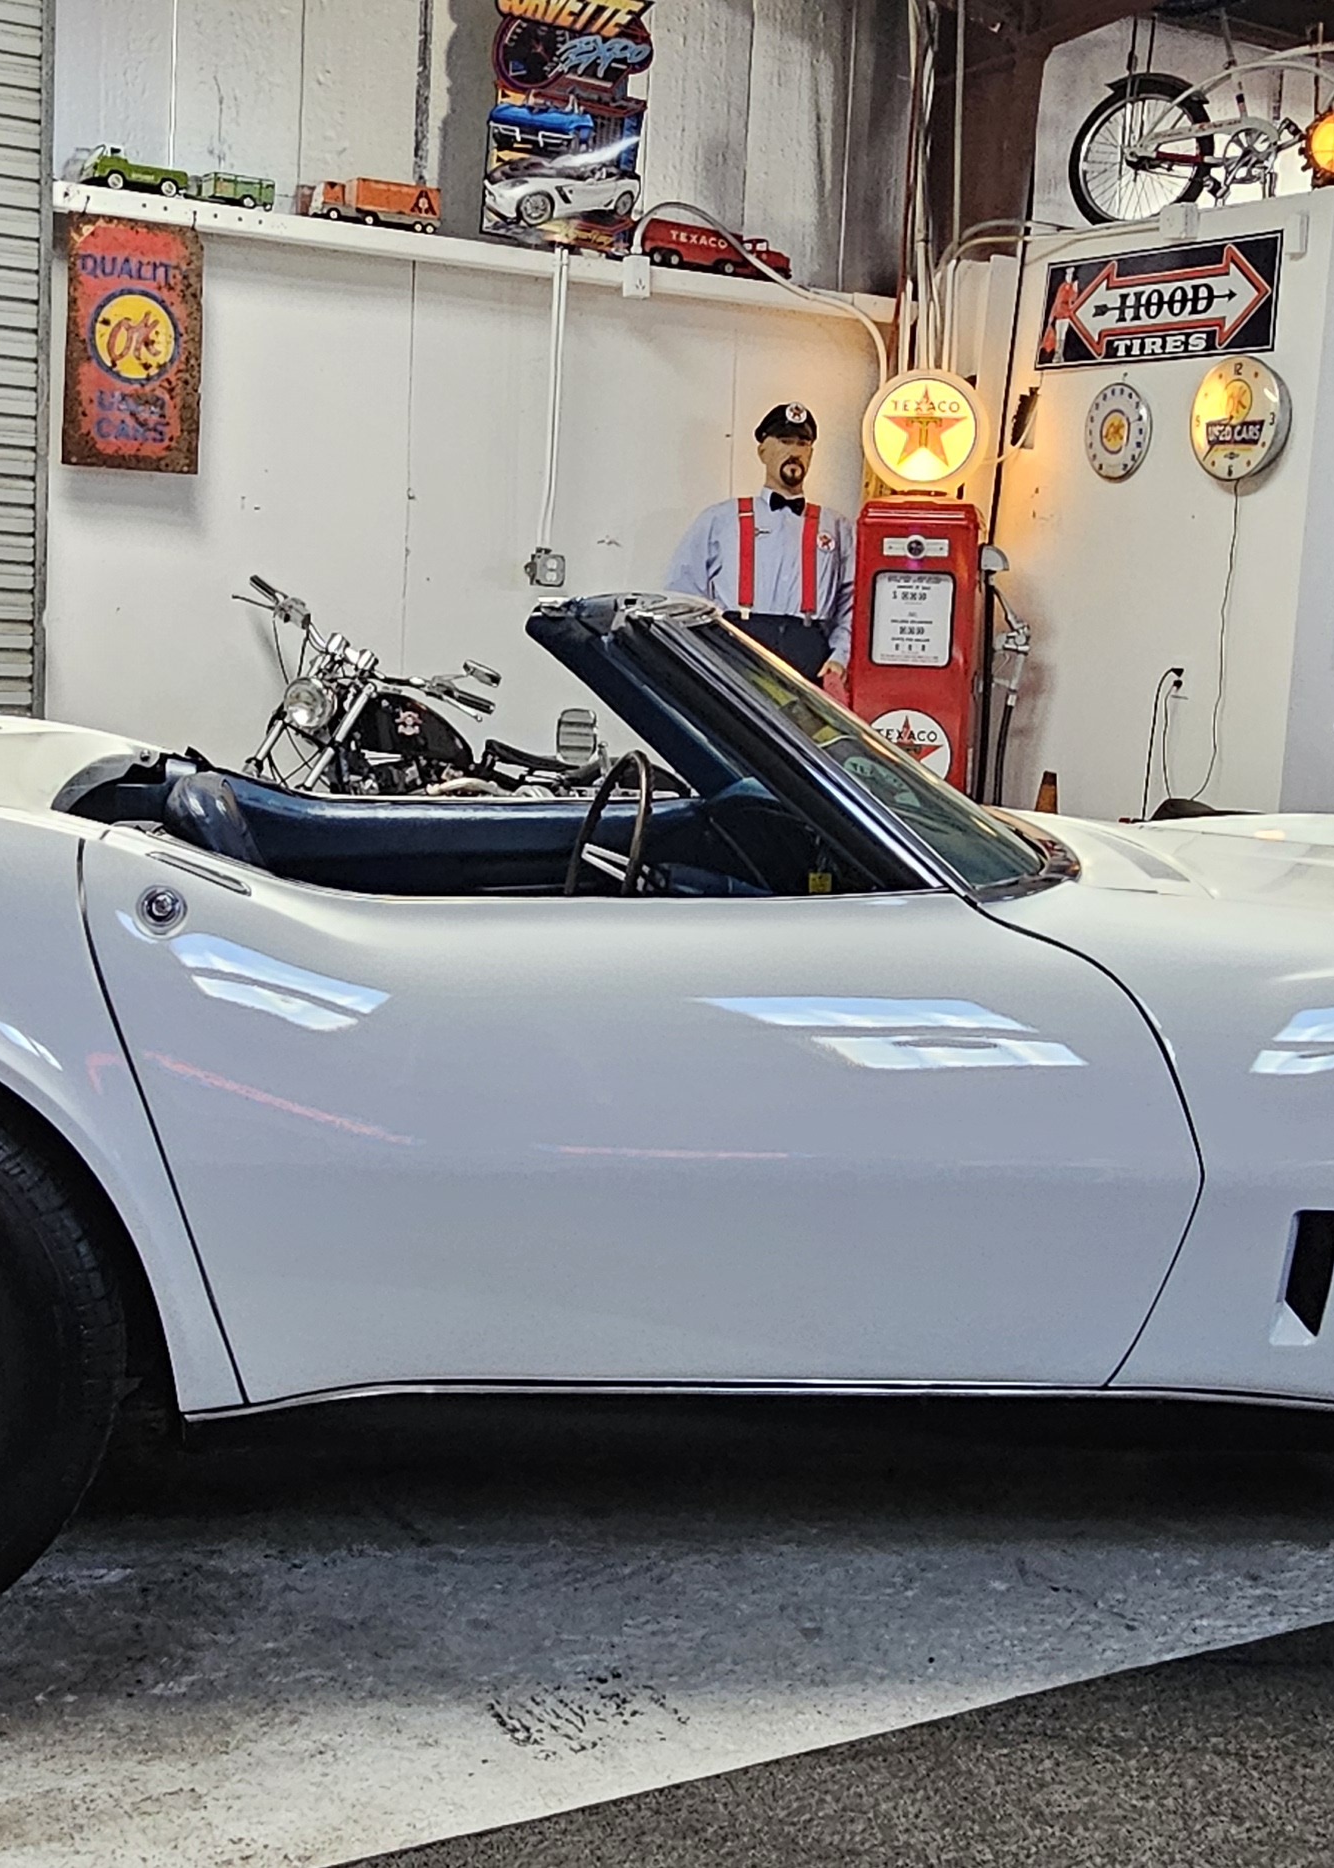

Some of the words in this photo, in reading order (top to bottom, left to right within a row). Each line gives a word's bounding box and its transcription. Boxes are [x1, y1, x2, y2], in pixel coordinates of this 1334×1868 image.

[670, 230, 728, 249] TEXACO
[1115, 282, 1215, 323] HOOD
[107, 310, 161, 363] OK
[1113, 333, 1207, 357] TIRES
[1233, 362, 1249, 376] 12
[891, 399, 961, 413] TEXACO
[1269, 411, 1276, 426] 3
[1234, 425, 1261, 441] CARS
[875, 729, 938, 743] TEXACO
